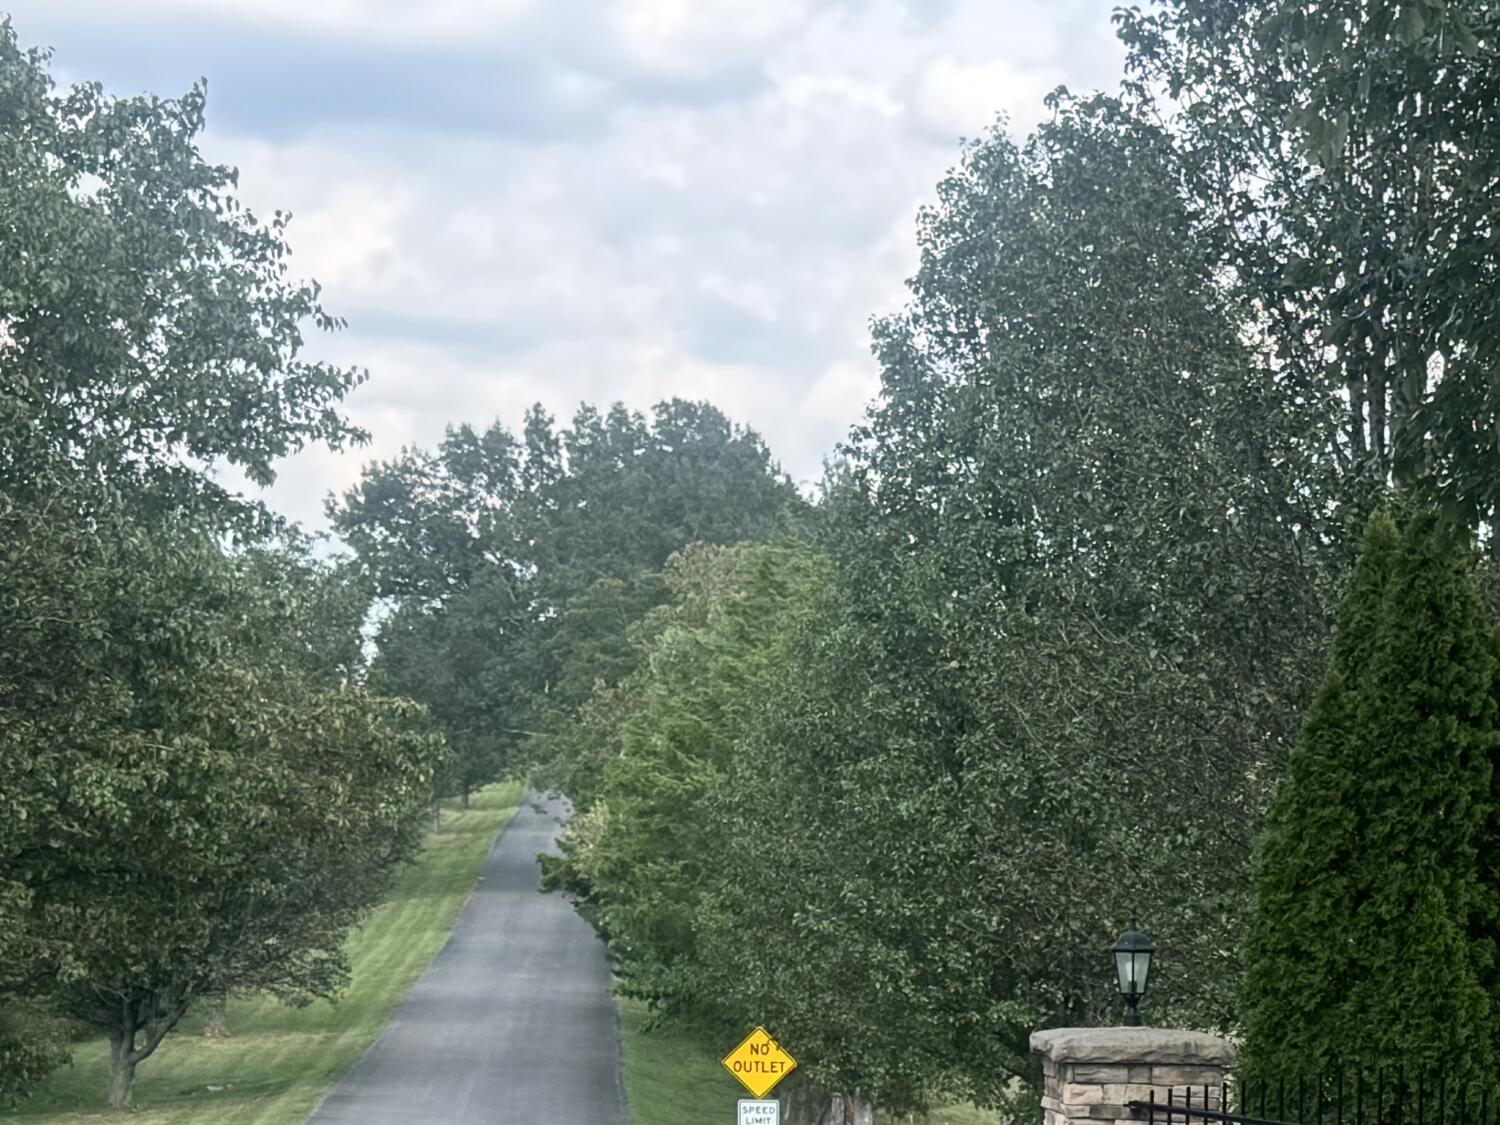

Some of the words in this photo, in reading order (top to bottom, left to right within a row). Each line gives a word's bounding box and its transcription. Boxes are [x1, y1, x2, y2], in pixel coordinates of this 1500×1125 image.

[750, 1043, 769, 1055] NO
[733, 1060, 786, 1073] OUTLET
[742, 1106, 776, 1115] SPEED
[745, 1117, 771, 1125] LIMIT
